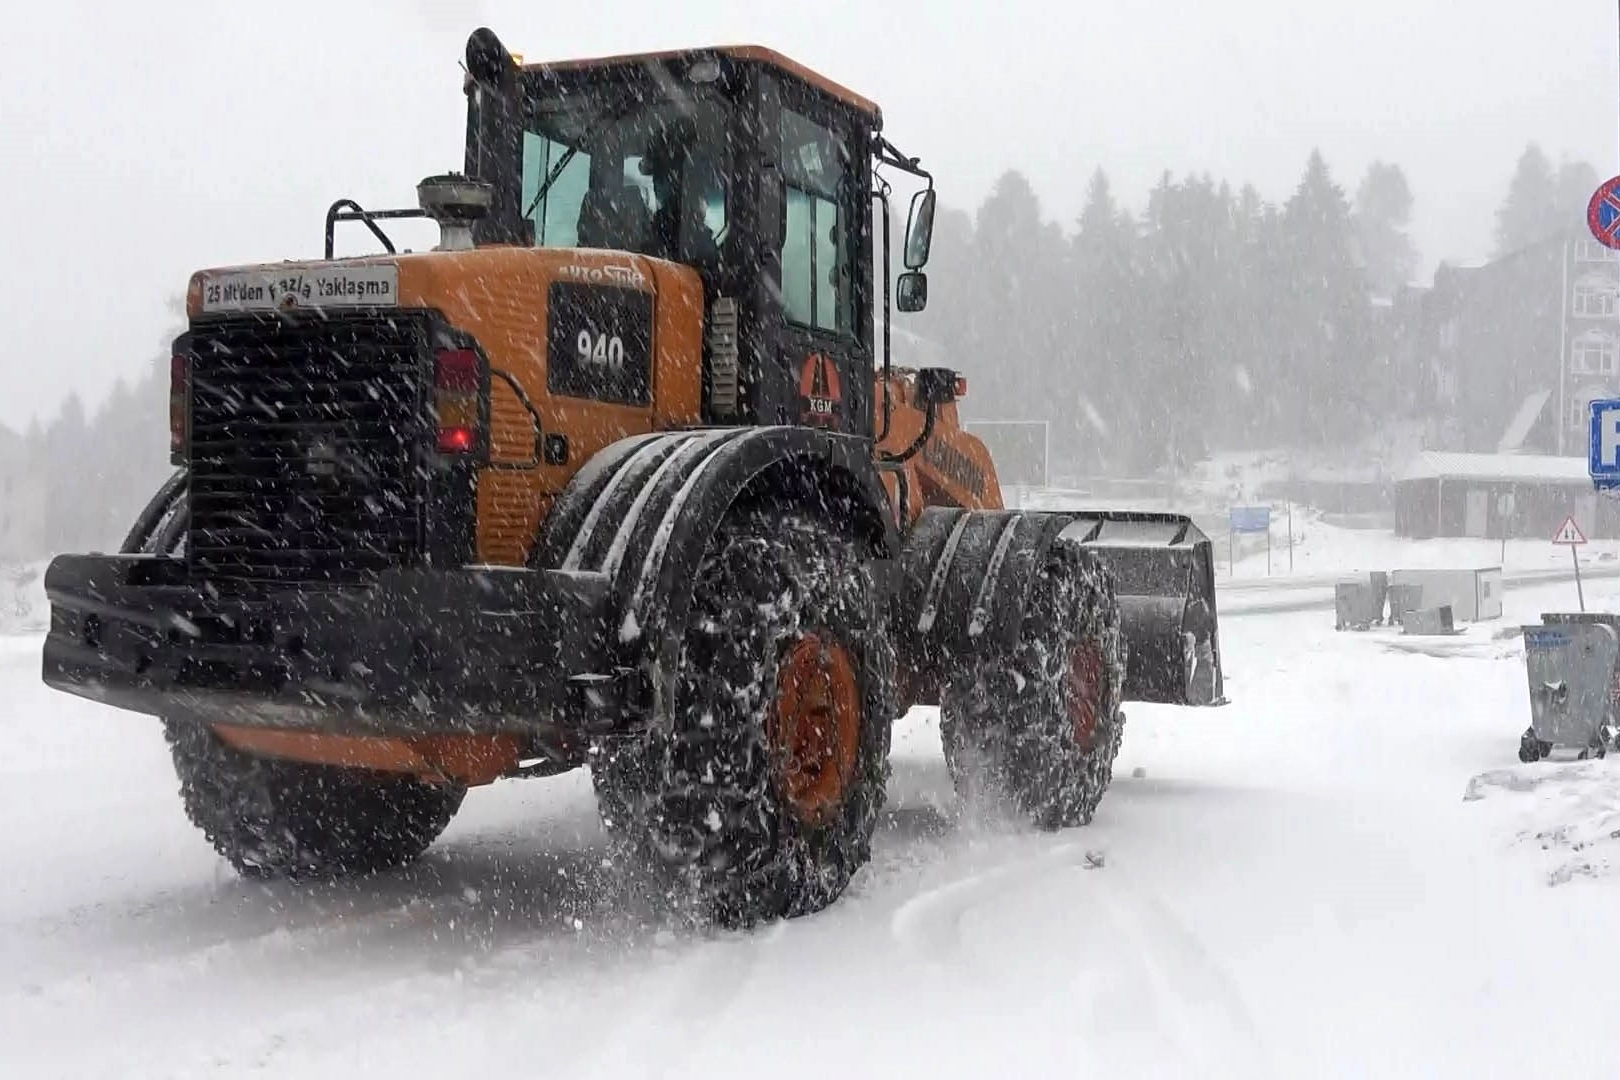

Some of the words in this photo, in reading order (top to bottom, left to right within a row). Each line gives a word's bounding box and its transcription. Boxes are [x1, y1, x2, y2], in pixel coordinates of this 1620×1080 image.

[208, 286, 220, 303] 25
[317, 276, 389, 300] Yaklaşma
[577, 329, 624, 370] 940
[810, 399, 832, 414] KGM
